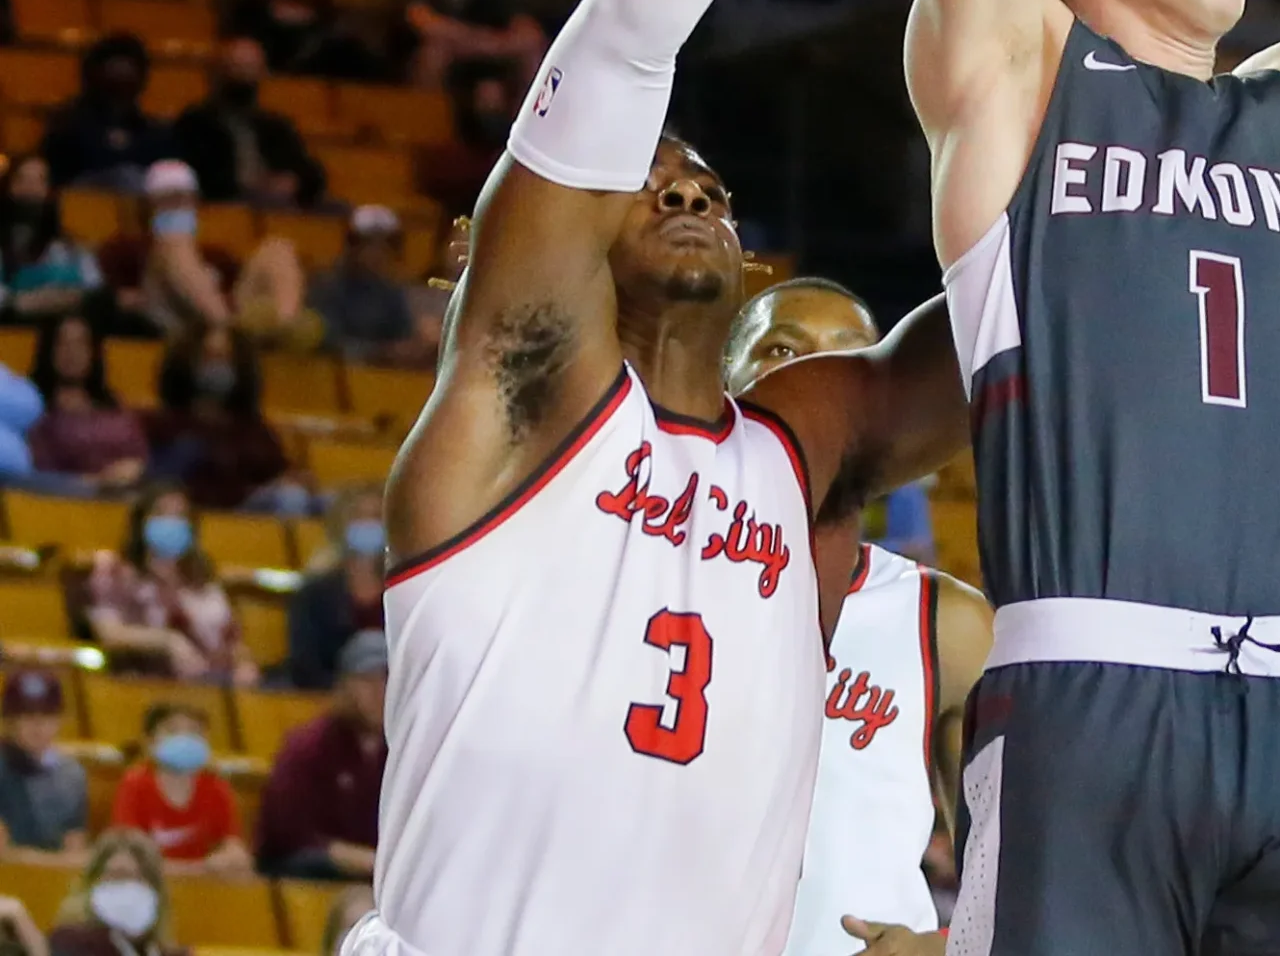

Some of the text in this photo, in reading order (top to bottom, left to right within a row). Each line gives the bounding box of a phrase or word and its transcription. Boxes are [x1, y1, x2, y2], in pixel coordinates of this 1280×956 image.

[1188, 249, 1247, 408] 1
[596, 440, 699, 548] Del
[623, 606, 713, 766] 3
[824, 656, 899, 750] ity
